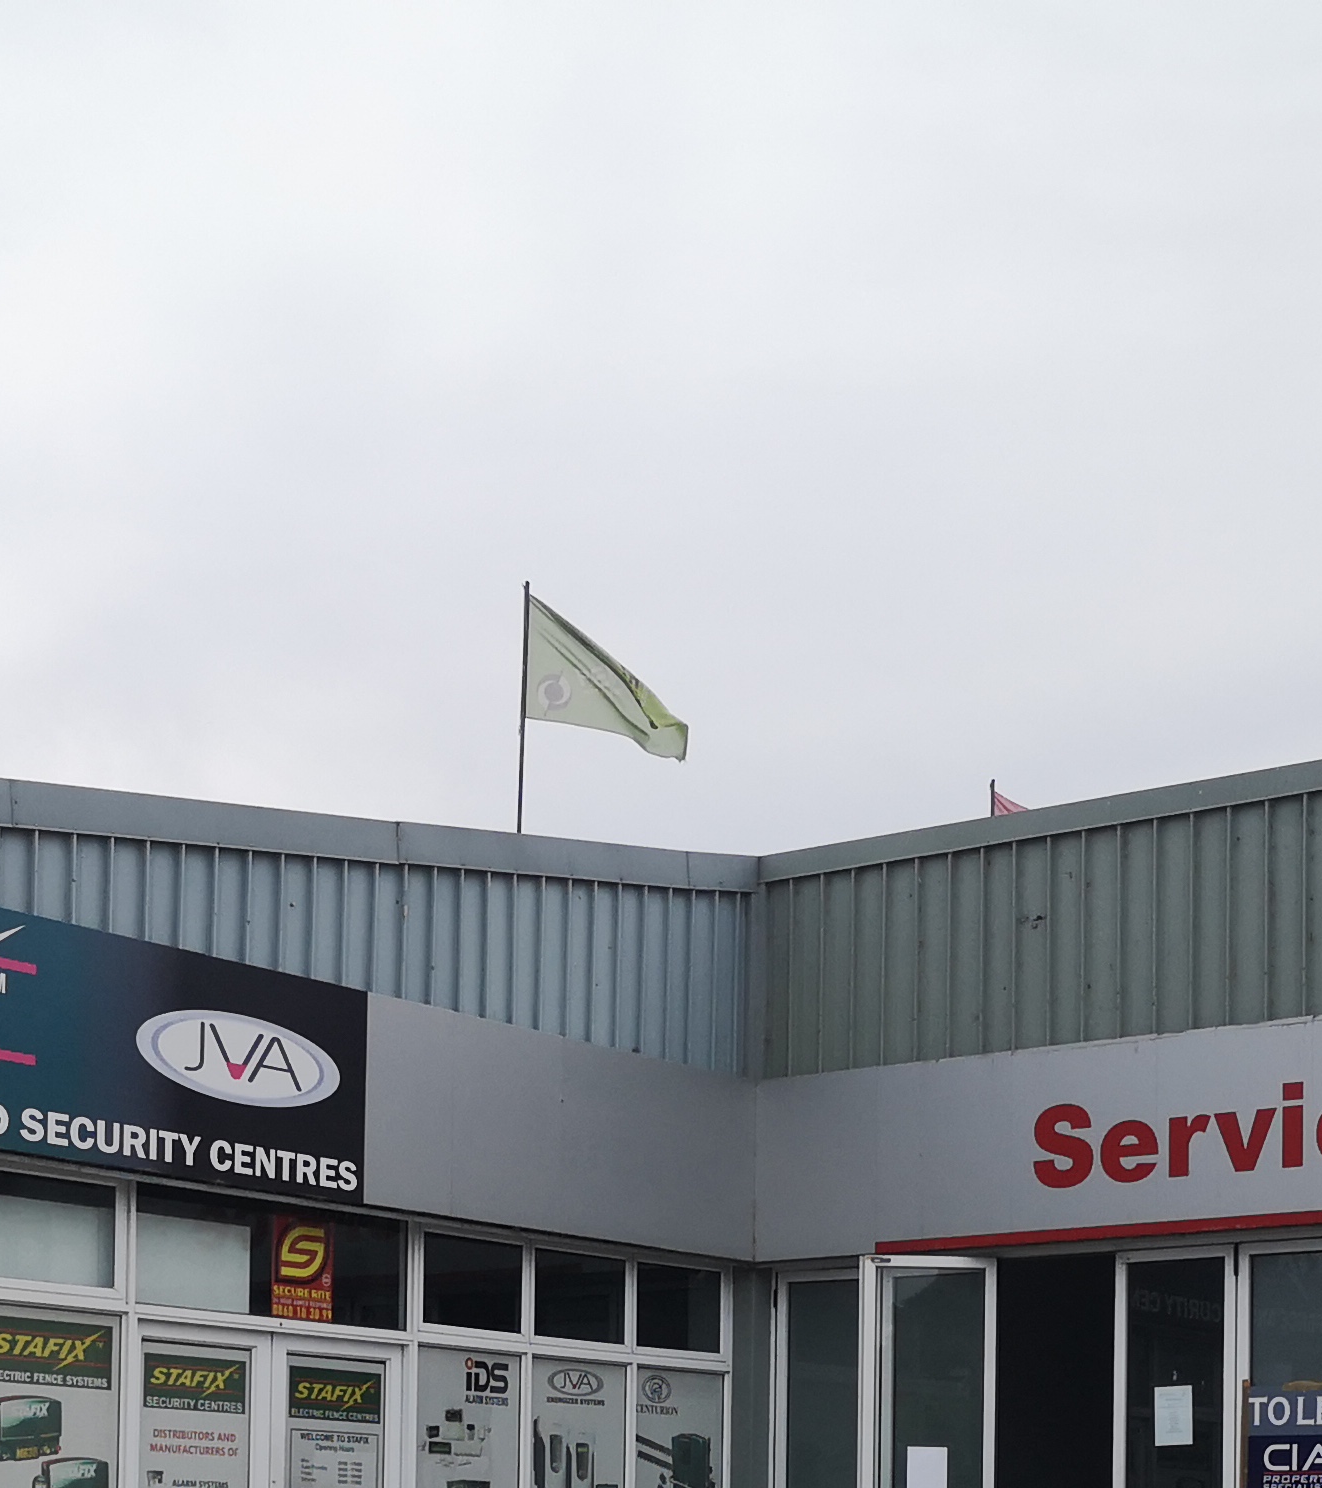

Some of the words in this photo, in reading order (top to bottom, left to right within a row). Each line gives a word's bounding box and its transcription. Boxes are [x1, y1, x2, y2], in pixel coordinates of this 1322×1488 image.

[184, 1020, 303, 1093] JVA
[19, 1107, 202, 1167] SECURITY
[209, 1139, 358, 1192] CENTRES
[273, 1285, 310, 1298] SECURE
[33, 1372, 64, 1385] FENCE
[65, 1374, 108, 1388] SYSTEMS
[150, 1365, 232, 1394] STAFIX
[560, 1372, 594, 1391] JVA
[294, 1381, 369, 1406] STAFIX
[146, 1396, 196, 1409] SECURITY
[198, 1399, 243, 1413] CENTRES
[636, 1404, 679, 1415] CENTURION
[1248, 1396, 1291, 1426] TO
[291, 1408, 324, 1418] ELECTRIC
[325, 1410, 348, 1419] FENCE
[348, 1412, 379, 1421] CENTRES
[152, 1428, 215, 1441] DISTRIBUTORS
[217, 1433, 237, 1443] AND
[300, 1433, 335, 1442] WELCOME
[336, 1434, 346, 1443] TO
[346, 1436, 370, 1445] STAFIX
[150, 1443, 226, 1456] MANUFACTURERS
[227, 1447, 239, 1457] OF
[171, 1480, 197, 1488] ALARM
[198, 1481, 229, 1488] SYSTEMS
